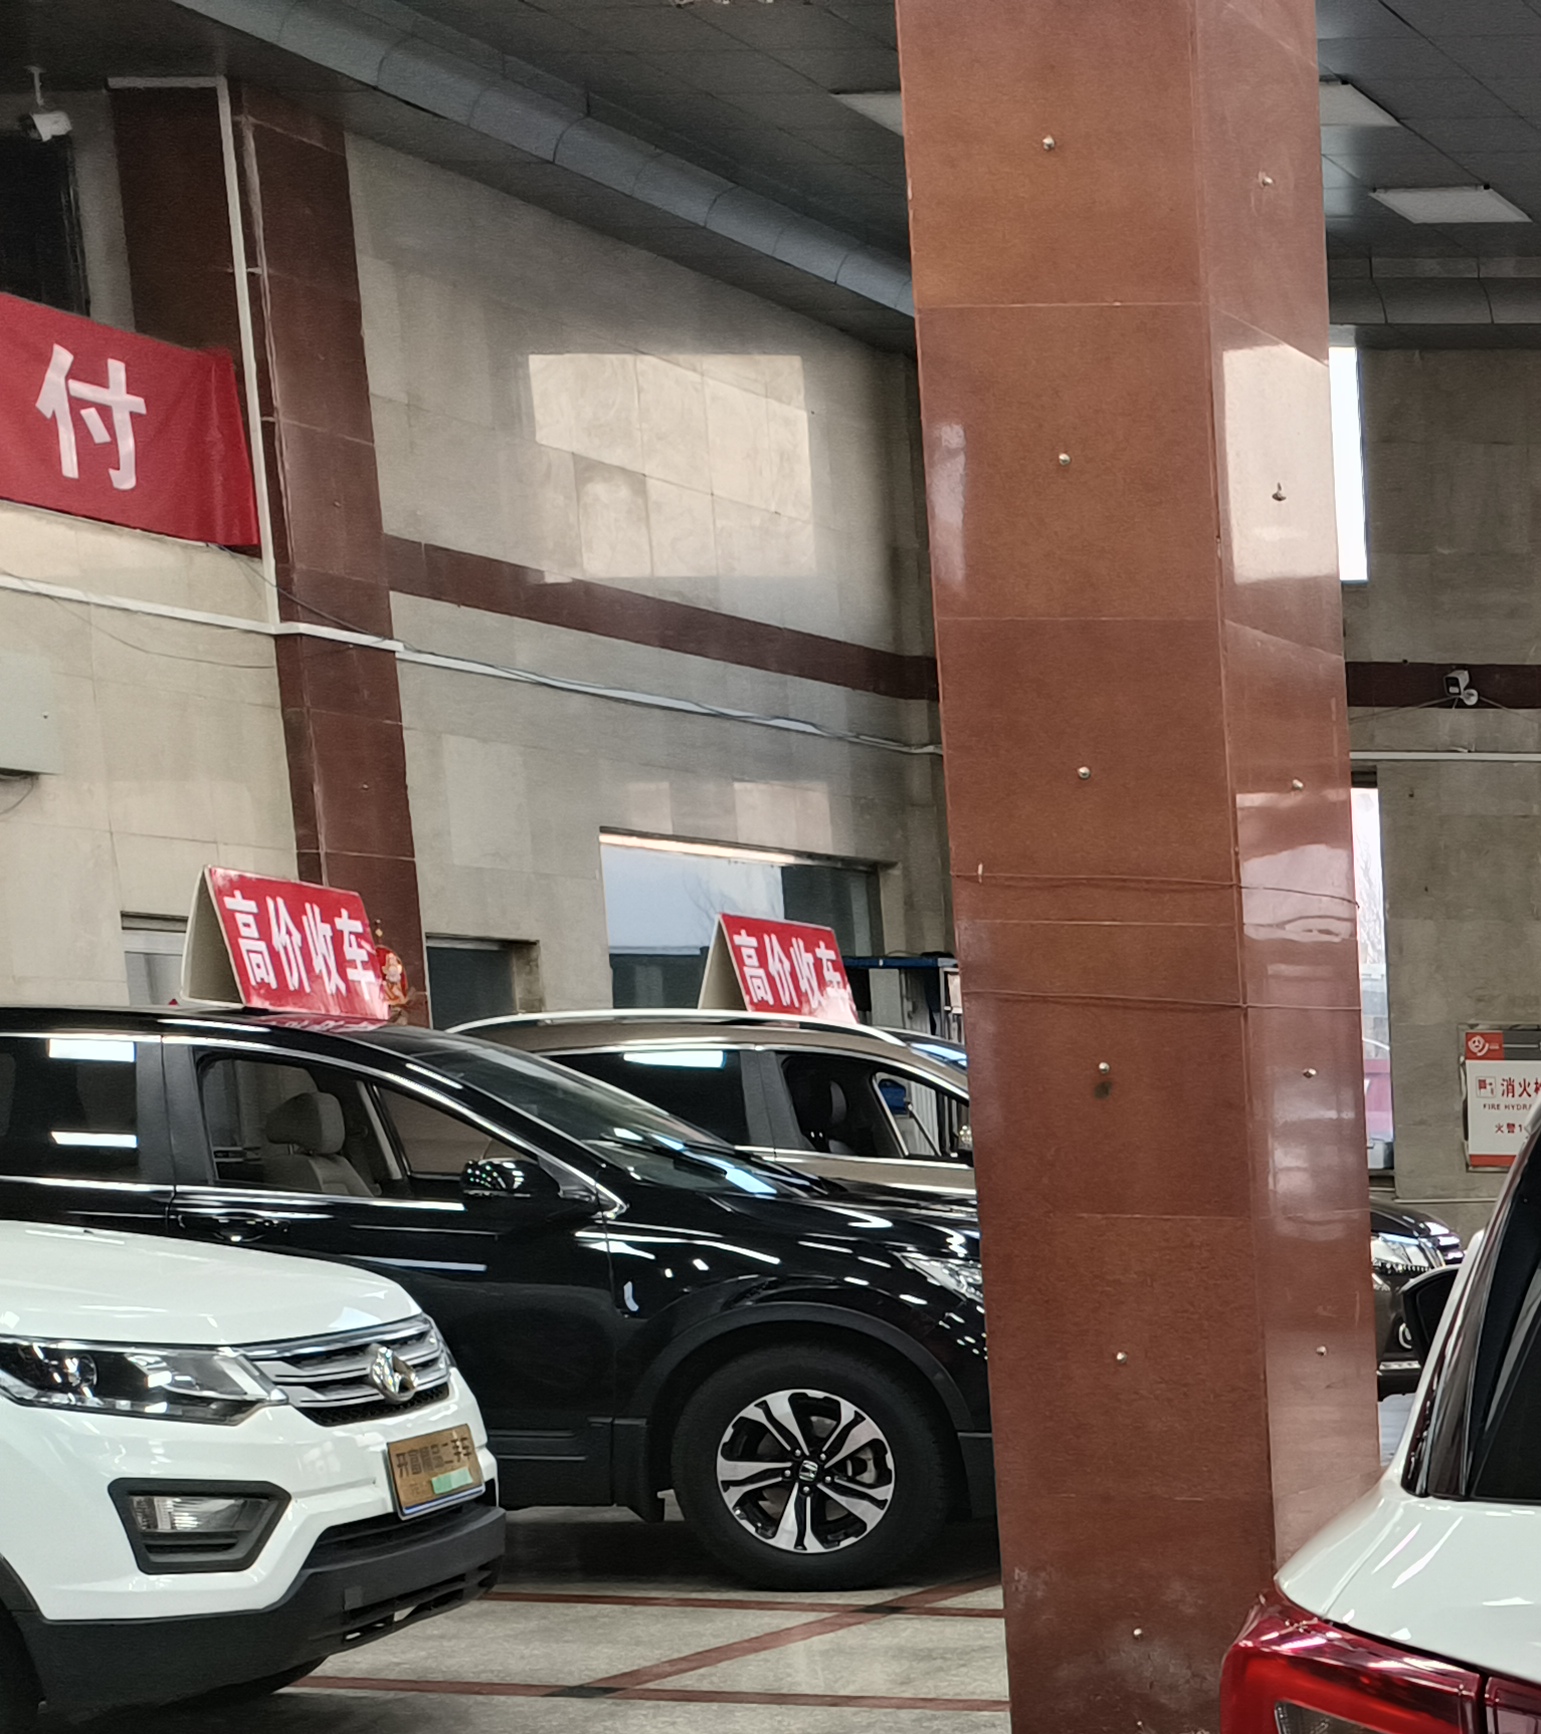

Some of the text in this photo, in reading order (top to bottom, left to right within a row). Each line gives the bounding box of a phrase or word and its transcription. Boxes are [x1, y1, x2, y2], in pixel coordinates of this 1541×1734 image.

[36, 343, 147, 491] 付
[223, 890, 376, 1000] 高价收车
[733, 929, 847, 1011] 高价收车
[1483, 1103, 1501, 1111] FIRE
